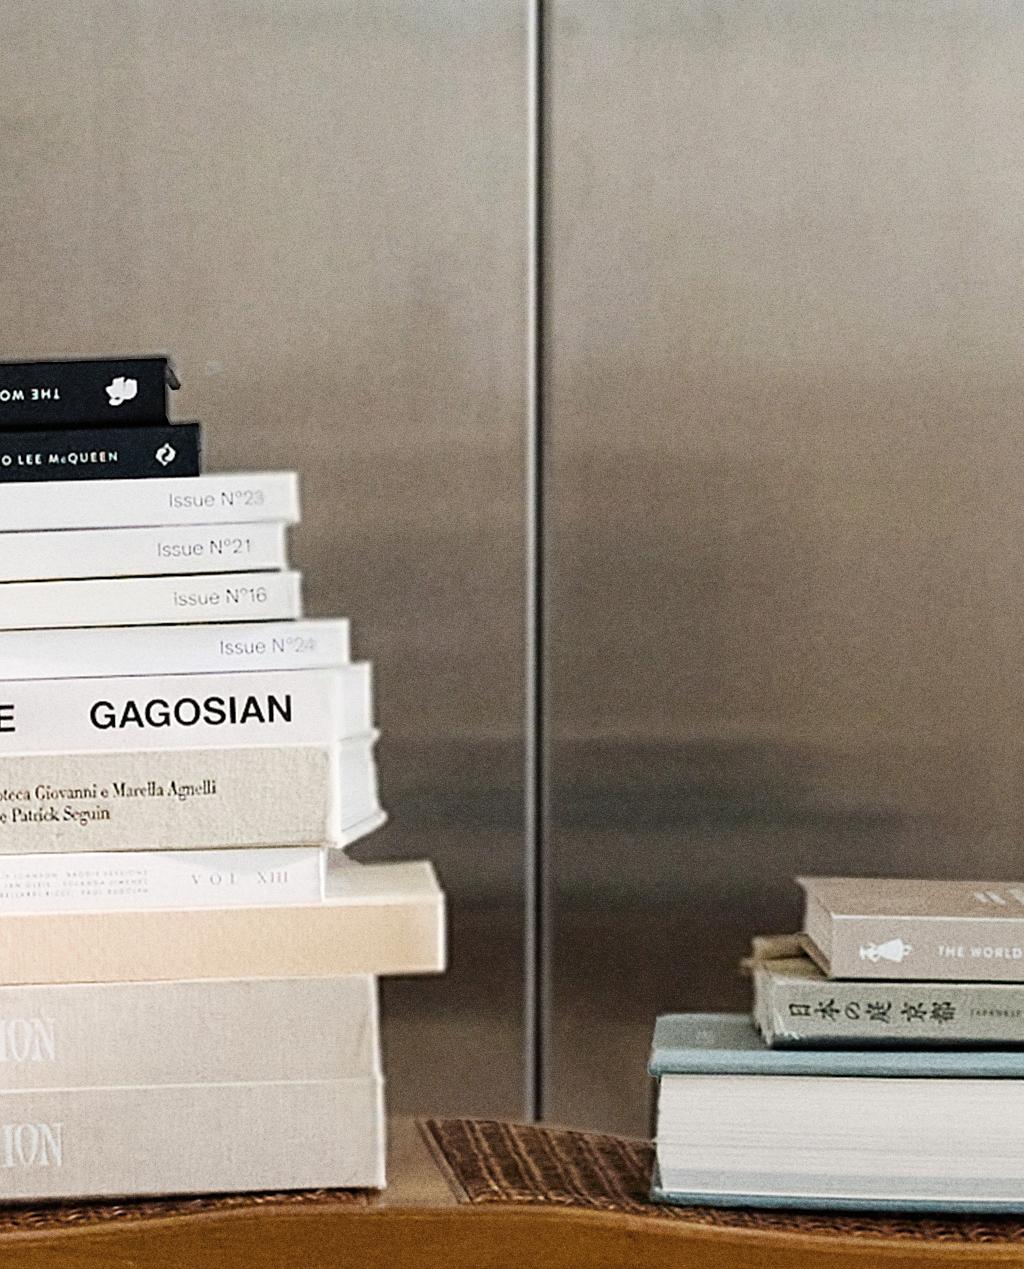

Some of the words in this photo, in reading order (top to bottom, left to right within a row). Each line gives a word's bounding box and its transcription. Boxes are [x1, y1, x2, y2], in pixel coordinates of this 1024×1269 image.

[31, 388, 60, 400] THE
[18, 453, 42, 465] LEE
[48, 451, 118, 465] McQUEEN
[169, 493, 215, 508] Issue
[157, 542, 204, 557] Issue
[220, 640, 266, 655] Issue
[90, 694, 292, 729] GAGOSIAN
[35, 784, 97, 800] Giovanni
[100, 789, 108, 798] e
[113, 781, 164, 798] Marella
[168, 779, 217, 801] Agnelli
[12, 807, 59, 823] Patrick
[63, 805, 110, 827] Seguin
[938, 945, 965, 957] THE
[971, 945, 1023, 959] WORLD
[2, 1123, 63, 1168] ION
